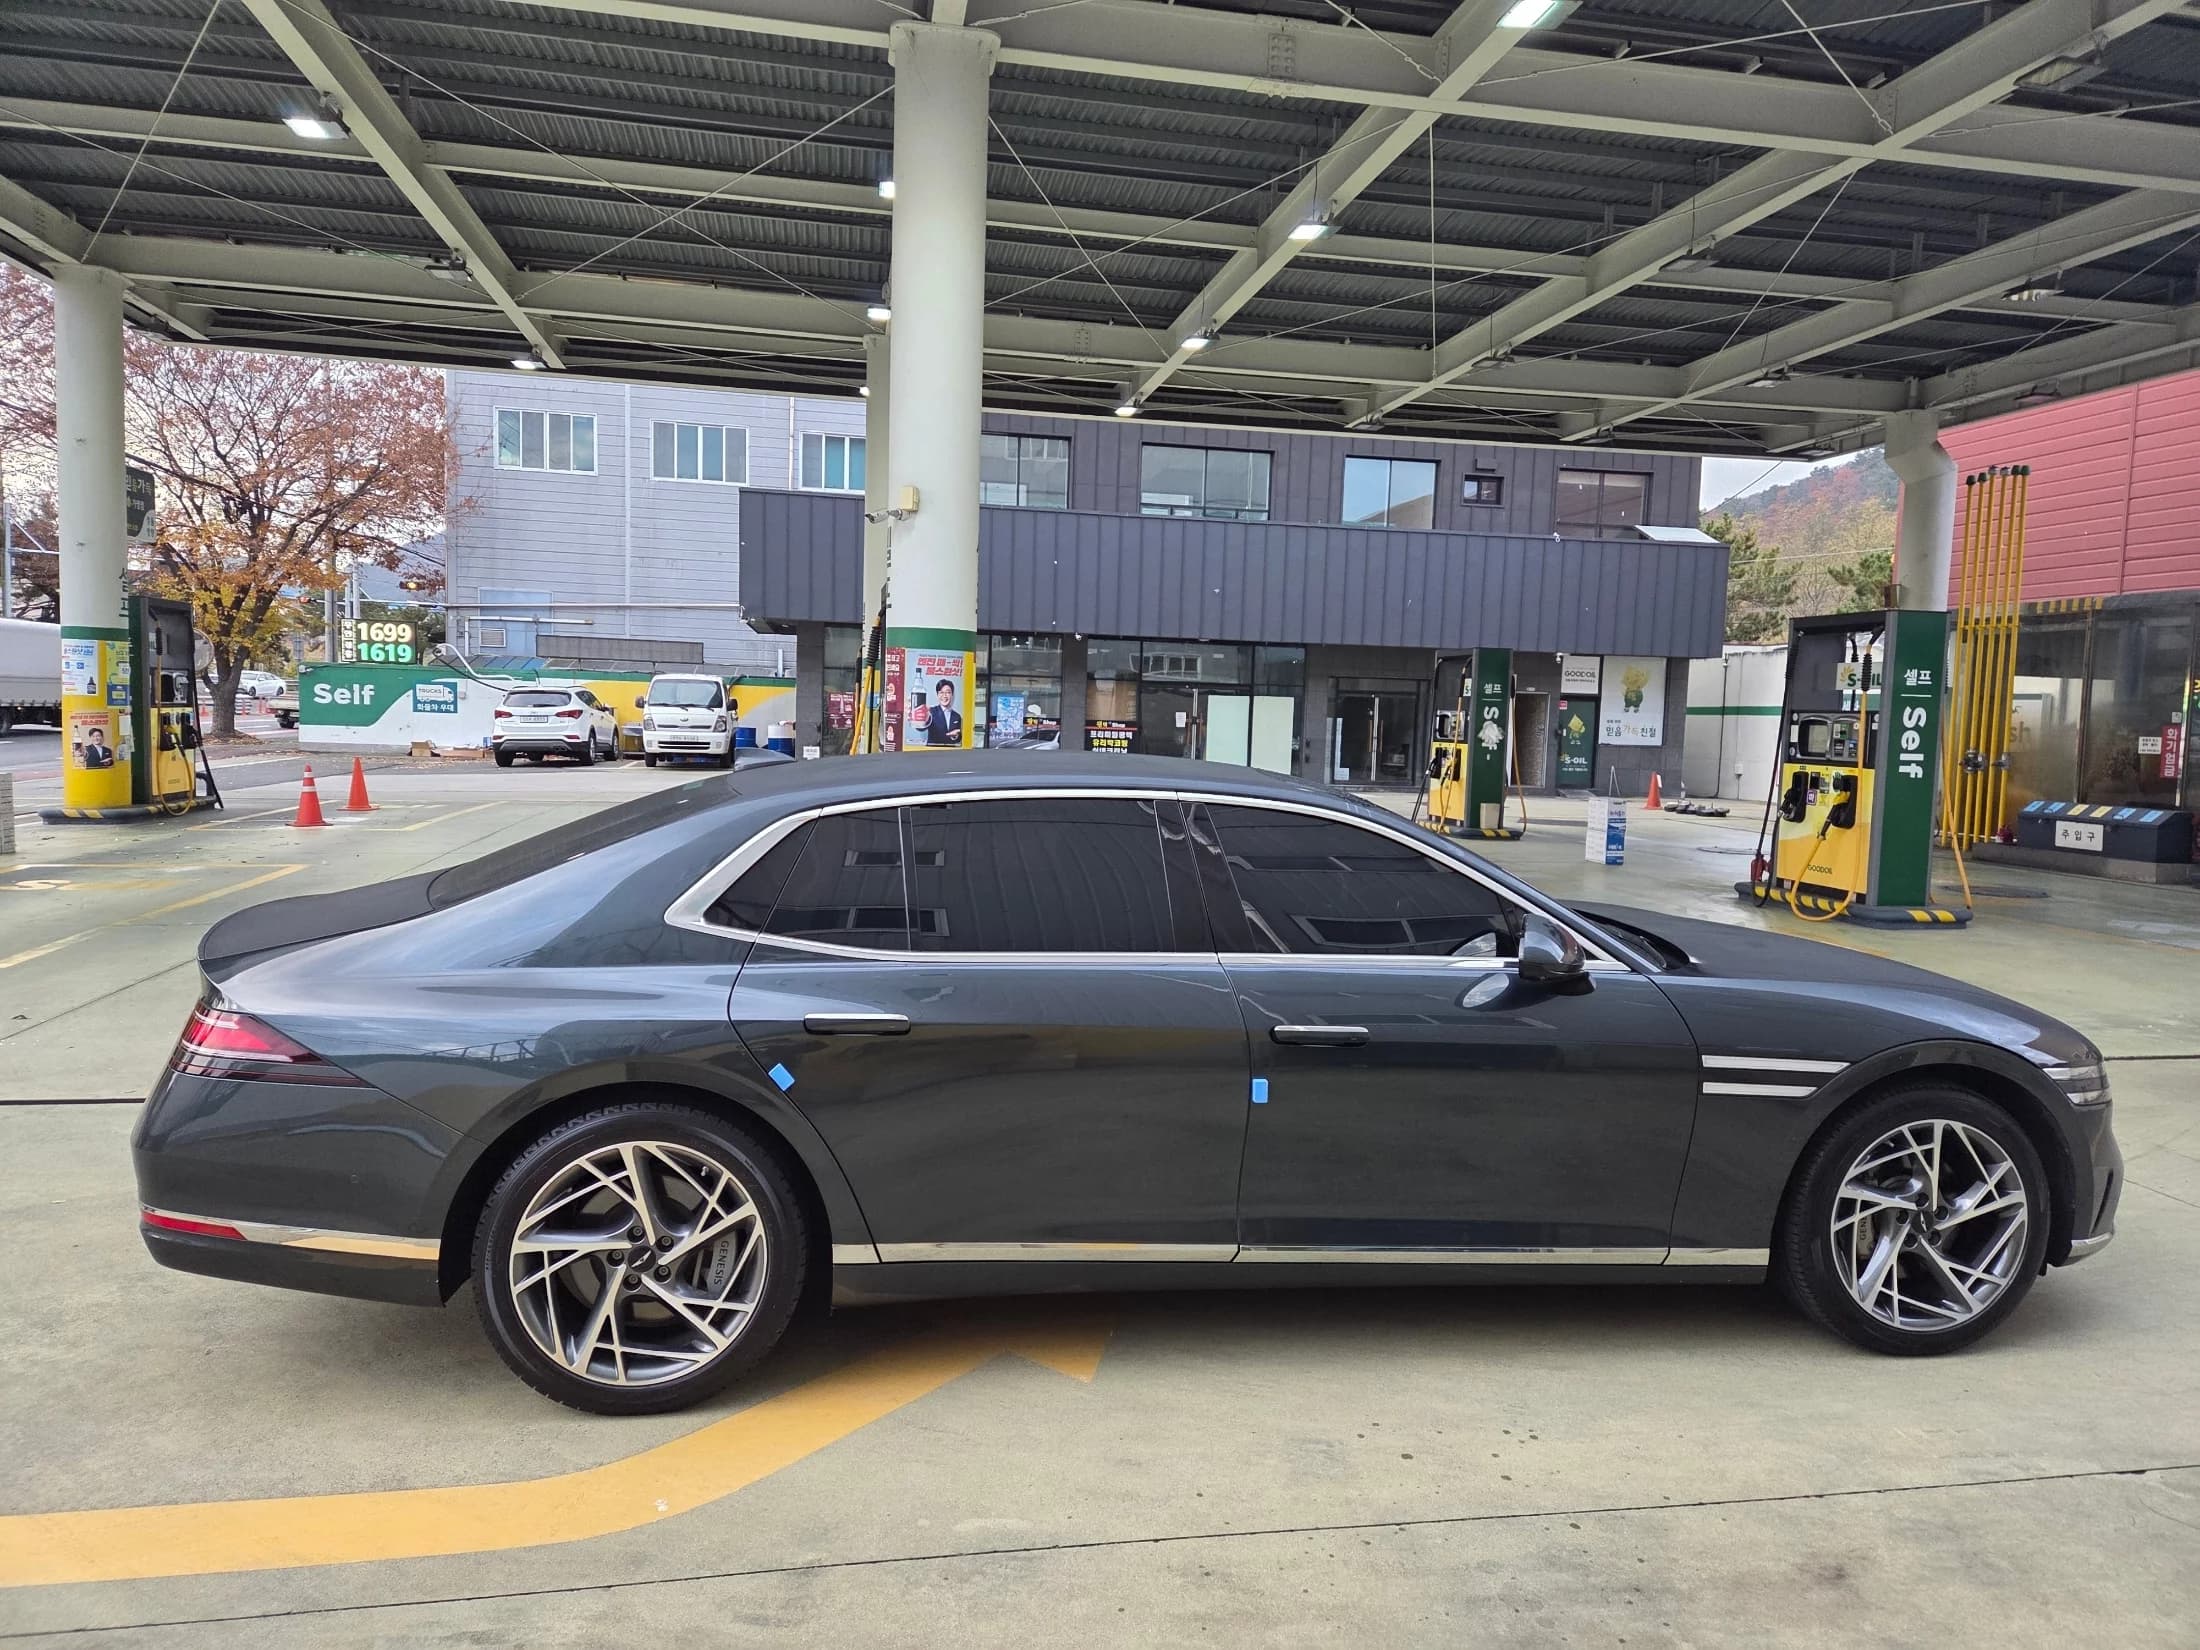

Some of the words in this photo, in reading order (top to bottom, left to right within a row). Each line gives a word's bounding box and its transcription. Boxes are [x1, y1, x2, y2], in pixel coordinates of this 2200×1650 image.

[357, 622, 413, 643] 1699
[357, 643, 413, 663] 1619
[1847, 673, 1881, 688] S-IL
[1904, 669, 1933, 686] 셀프
[313, 683, 375, 705] Self
[1483, 683, 1503, 694] 셀프
[1898, 706, 1927, 779] Self
[2163, 727, 2178, 777] 화기엄금
[1564, 756, 1588, 765] S-OIL
[714, 1240, 729, 1286] GENESIS
